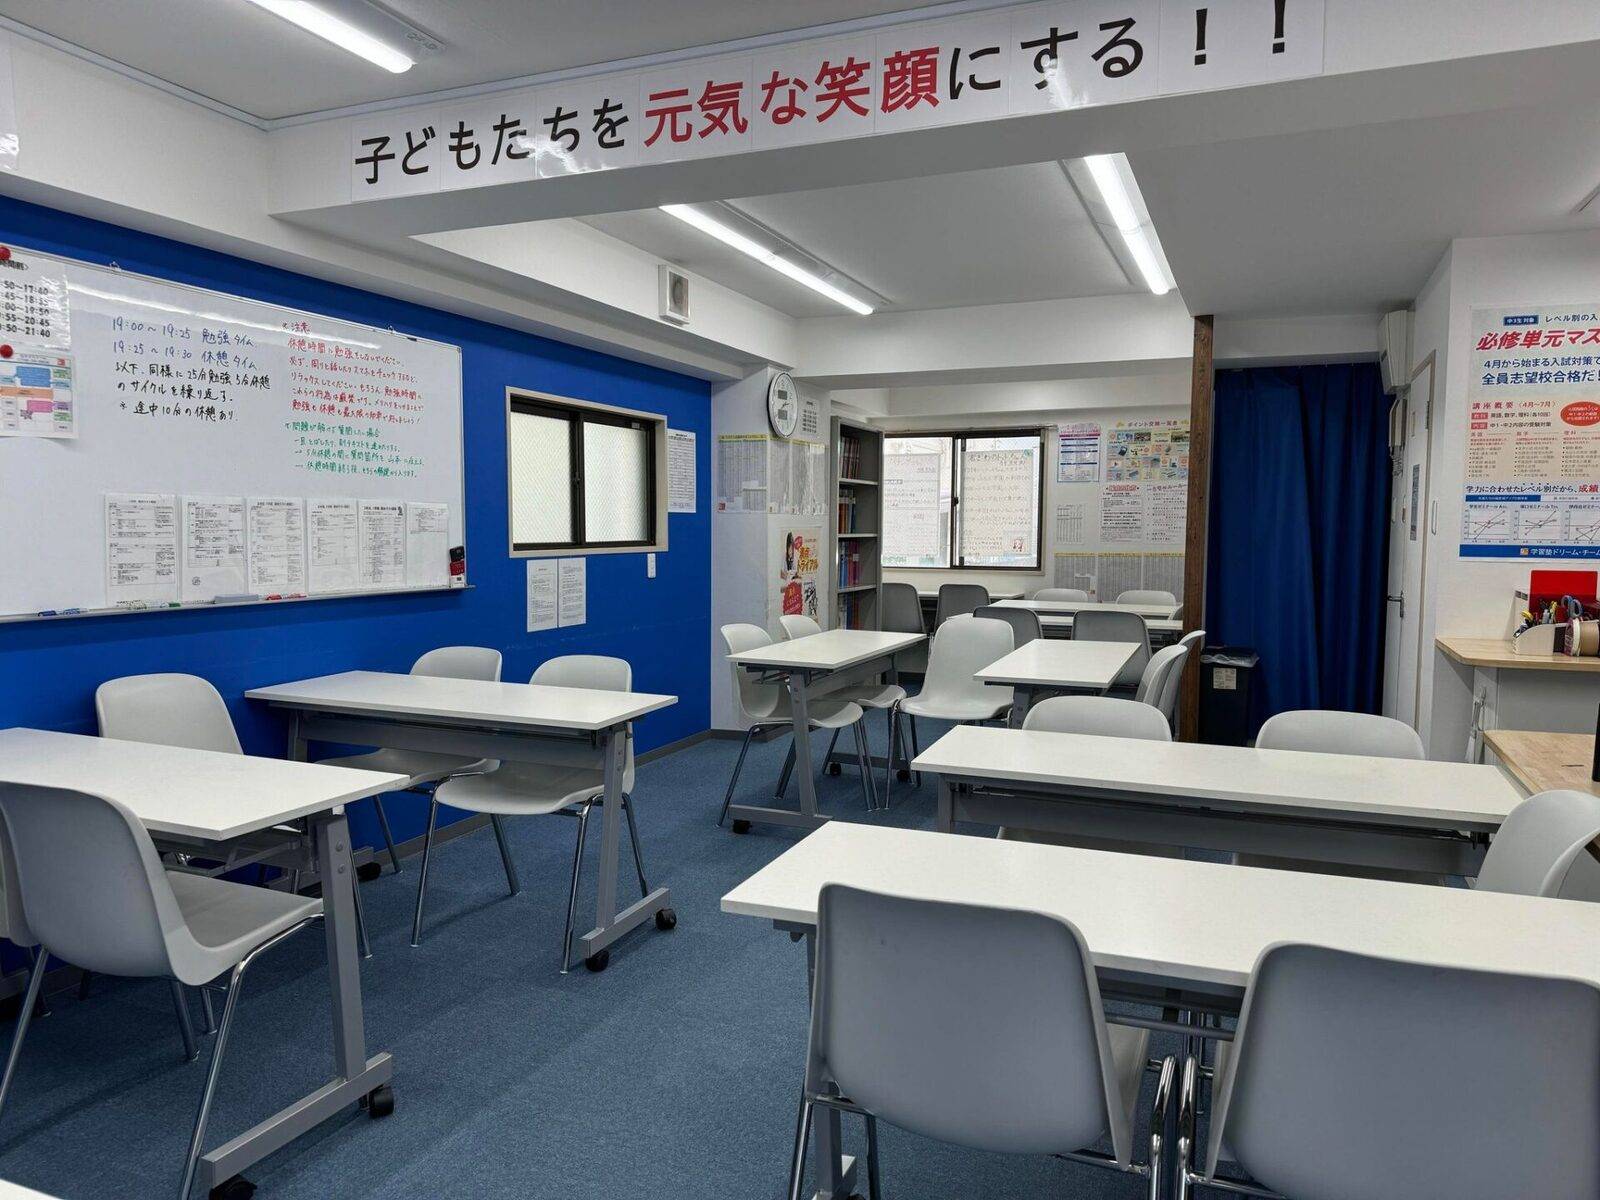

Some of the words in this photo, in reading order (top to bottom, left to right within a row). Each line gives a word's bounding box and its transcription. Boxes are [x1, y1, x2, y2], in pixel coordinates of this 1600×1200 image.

[1476, 329, 1600, 350] 必修単元マス
